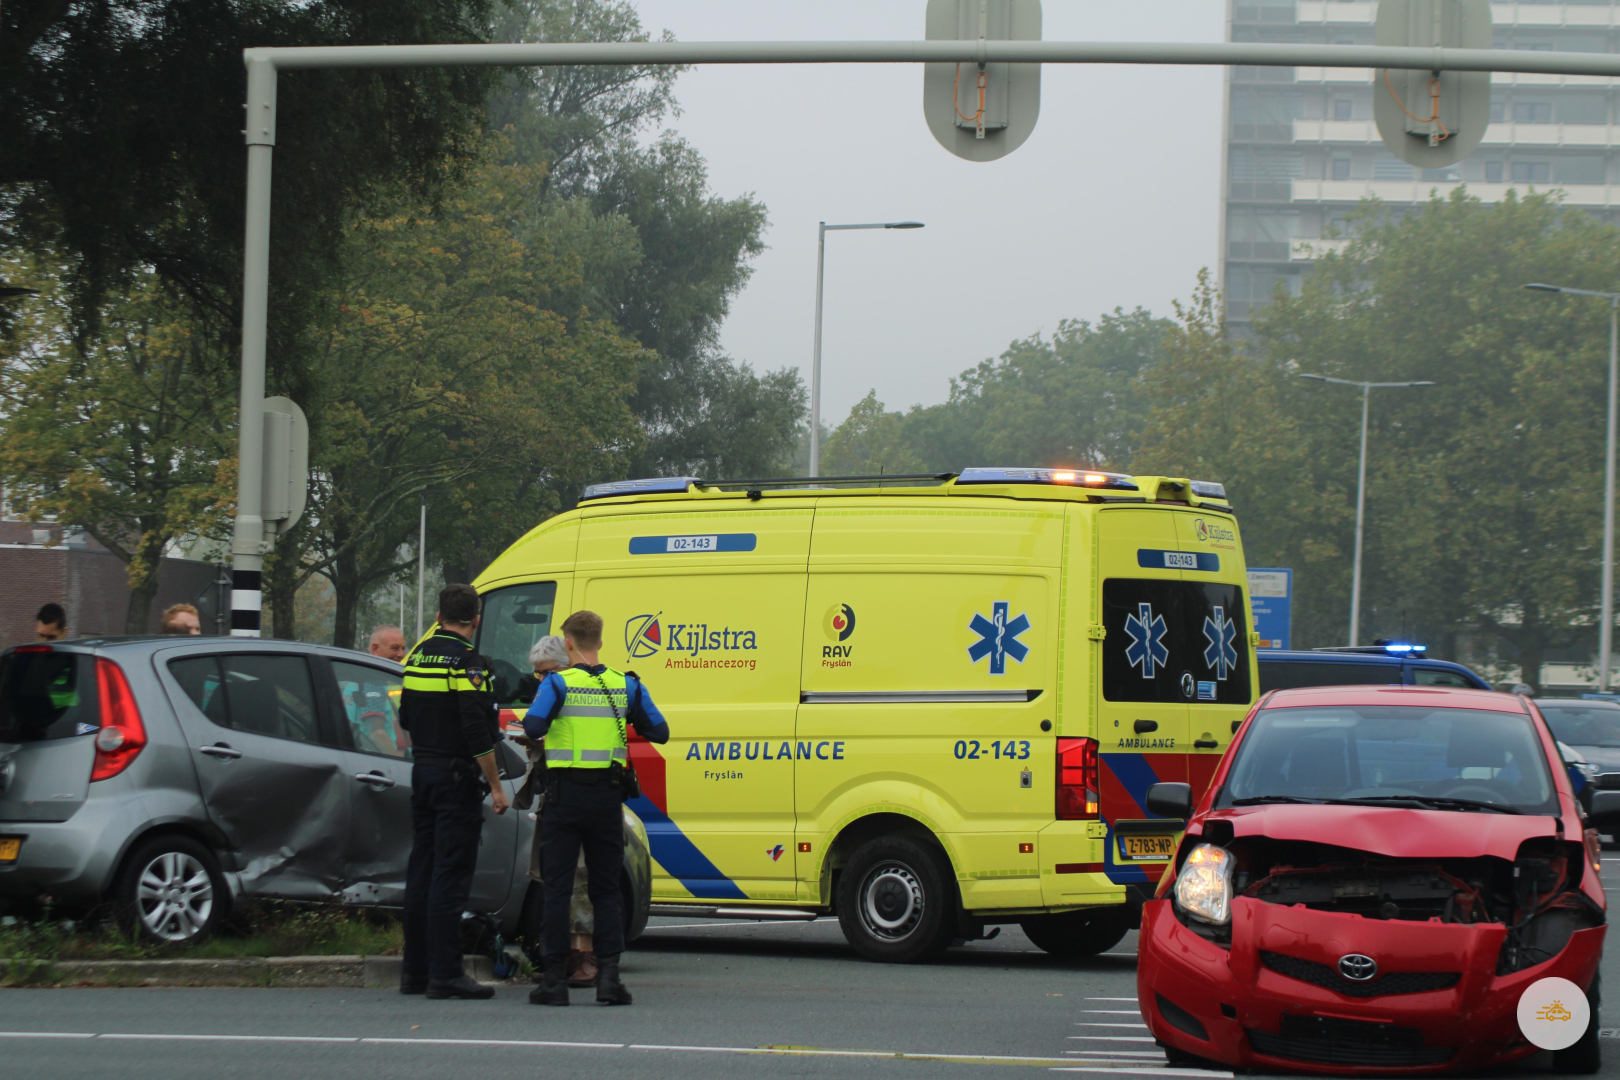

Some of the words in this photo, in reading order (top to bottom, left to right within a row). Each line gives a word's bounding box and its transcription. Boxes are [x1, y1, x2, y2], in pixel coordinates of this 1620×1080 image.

[1208, 524, 1234, 542] Kijlstra
[673, 538, 710, 549] 02-143
[1168, 555, 1193, 567] 02-143
[666, 624, 757, 656] Kijlstra
[822, 645, 852, 658] RAV
[665, 658, 757, 670] Ambulancezorg
[1117, 738, 1174, 748] AMBULANCE
[686, 741, 845, 761] AMBULANCE
[954, 740, 1031, 760] 02-143
[704, 770, 744, 782] Fryslân
[1128, 838, 1171, 853] Z-783-NP
